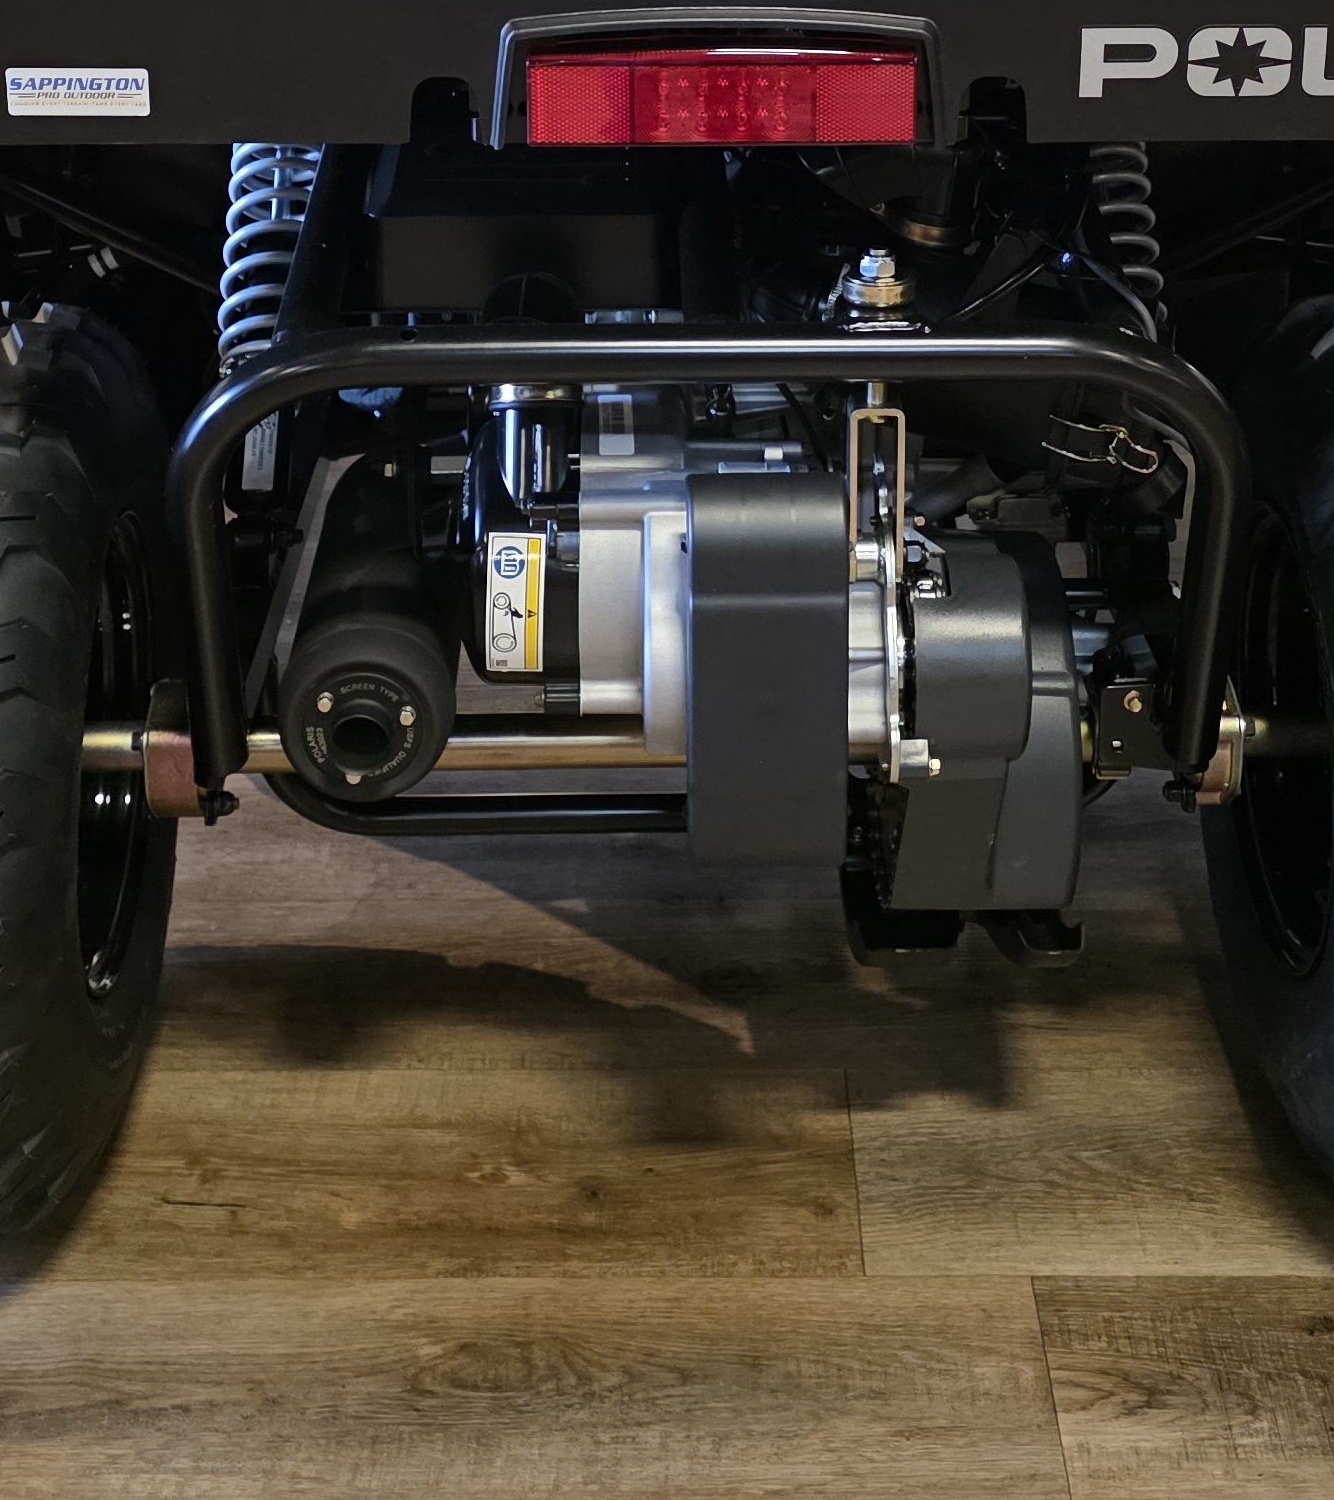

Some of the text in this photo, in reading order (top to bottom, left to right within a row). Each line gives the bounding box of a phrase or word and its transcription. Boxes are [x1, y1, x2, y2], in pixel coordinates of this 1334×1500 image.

[9, 77, 145, 91] SAPPINGTON
[37, 91, 116, 99] PRO OUTDOOR
[340, 682, 400, 703] SCREEN TYPE
[305, 726, 326, 764] POLARIS
[403, 727, 414, 749] USFS
